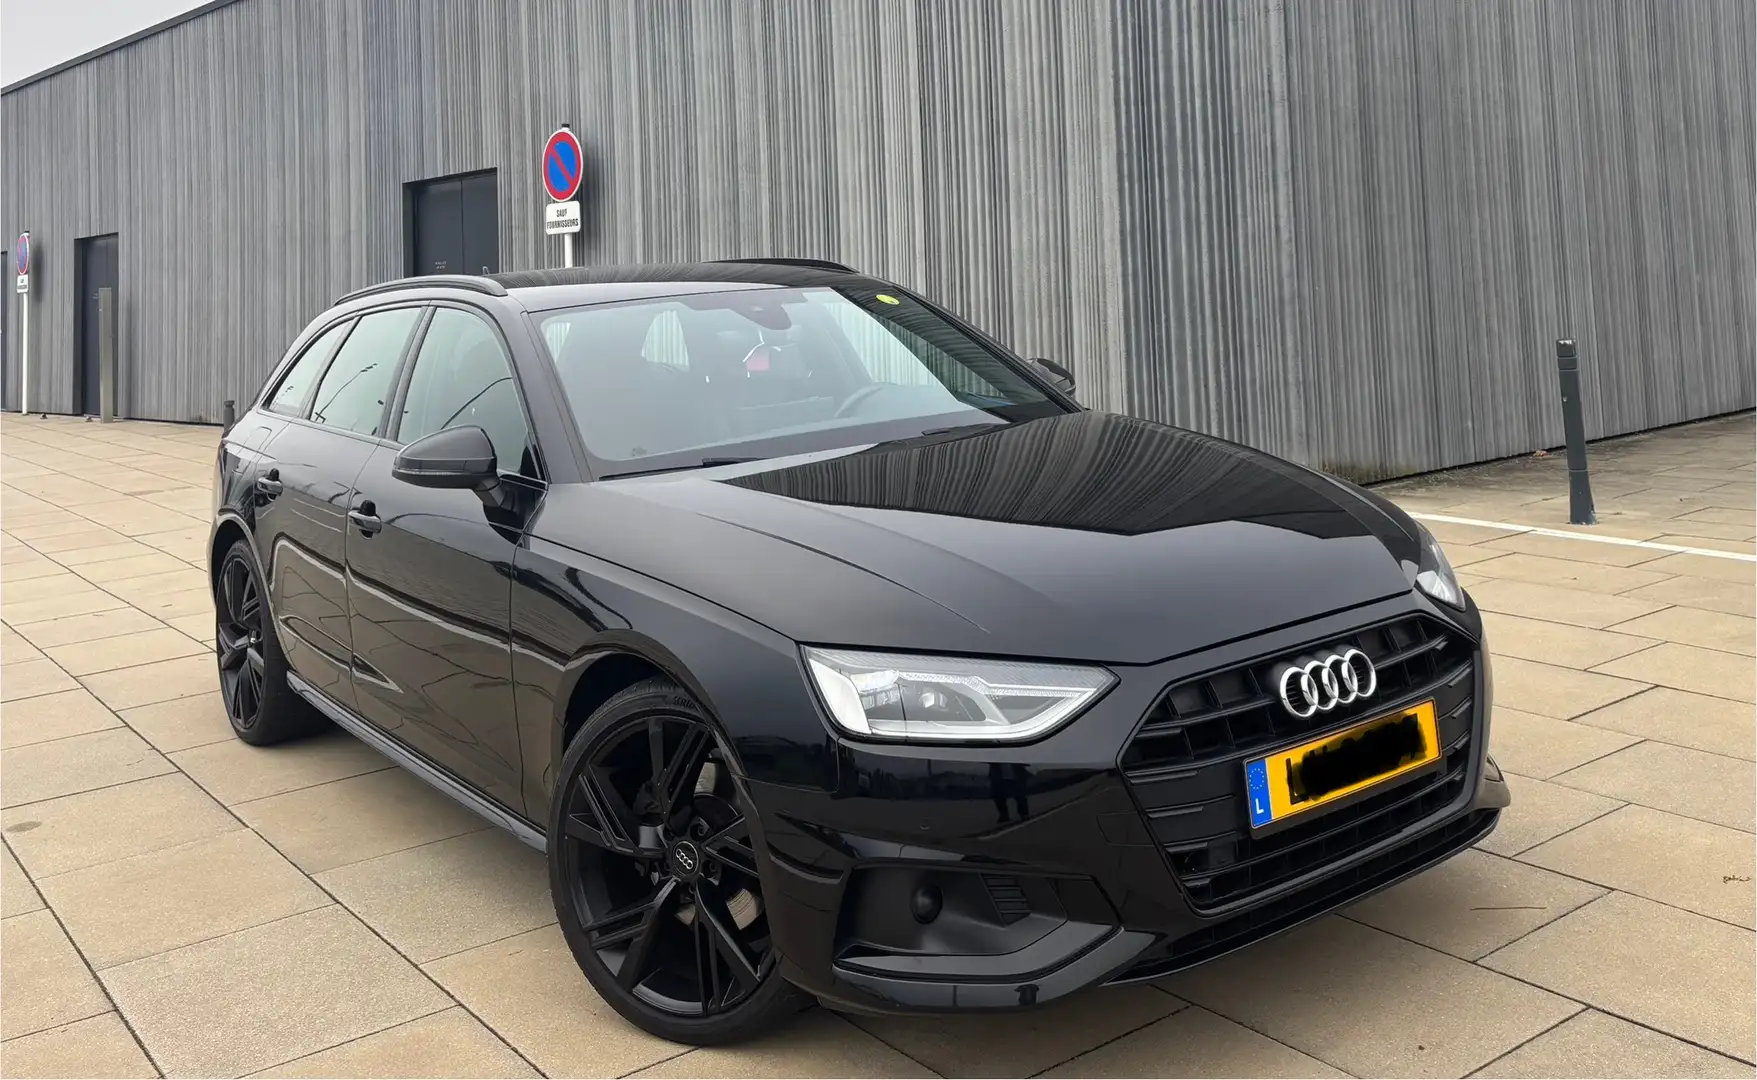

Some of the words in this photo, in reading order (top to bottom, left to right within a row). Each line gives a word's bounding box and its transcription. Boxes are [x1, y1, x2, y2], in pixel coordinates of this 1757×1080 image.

[556, 208, 568, 218] SAUF
[547, 218, 579, 229] FOURNISSEURS
[1255, 798, 1264, 815] L
